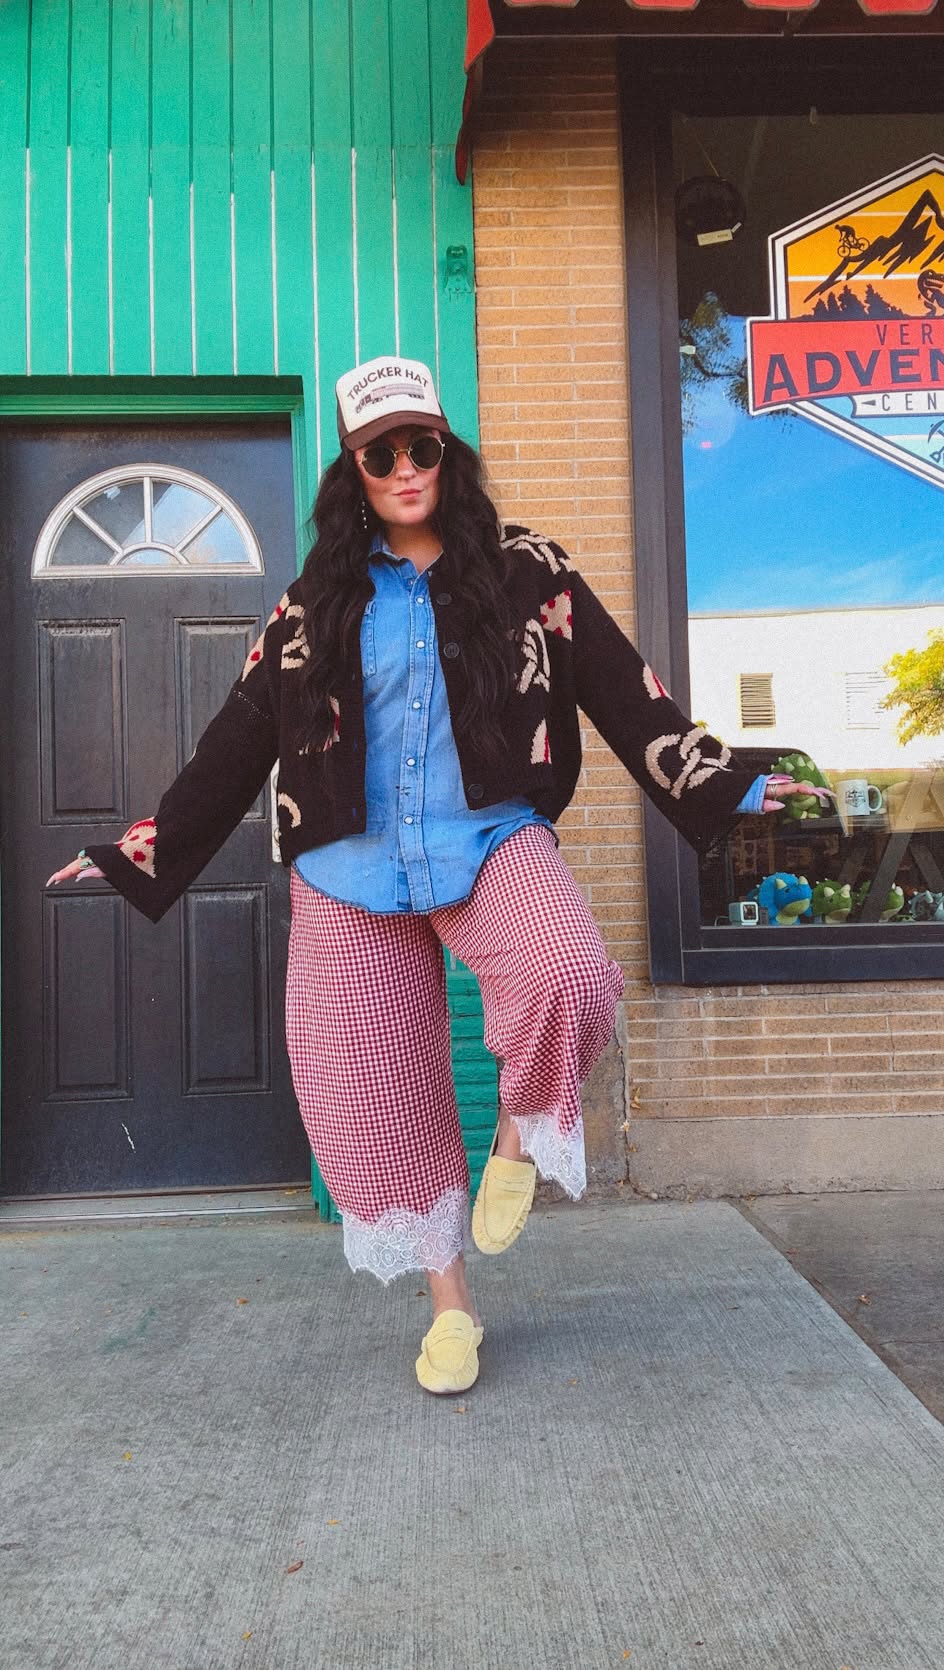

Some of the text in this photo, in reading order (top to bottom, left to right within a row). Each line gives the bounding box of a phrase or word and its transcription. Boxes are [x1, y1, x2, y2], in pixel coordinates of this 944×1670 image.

[876, 323, 934, 346] VER
[347, 366, 429, 400] TRUCKER HAT
[881, 392, 938, 412] CEN
